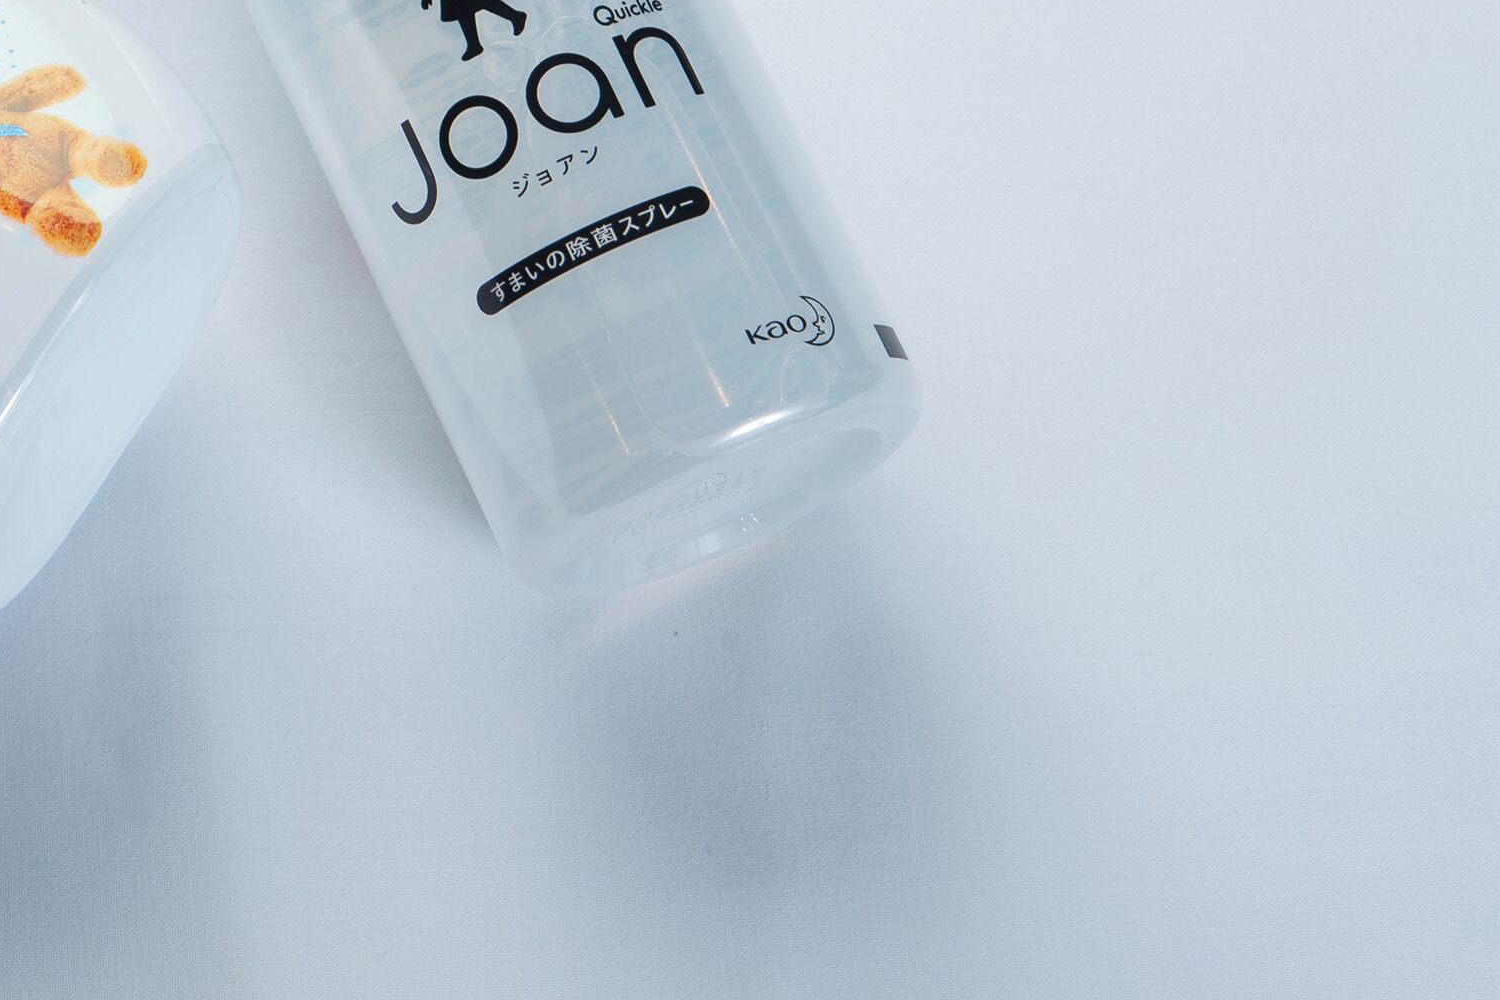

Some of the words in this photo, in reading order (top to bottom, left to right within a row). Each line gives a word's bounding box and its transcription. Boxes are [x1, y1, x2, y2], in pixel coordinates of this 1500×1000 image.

[512, 146, 598, 197] ジョアン
[490, 199, 694, 302] すまいの除菌スプレー
